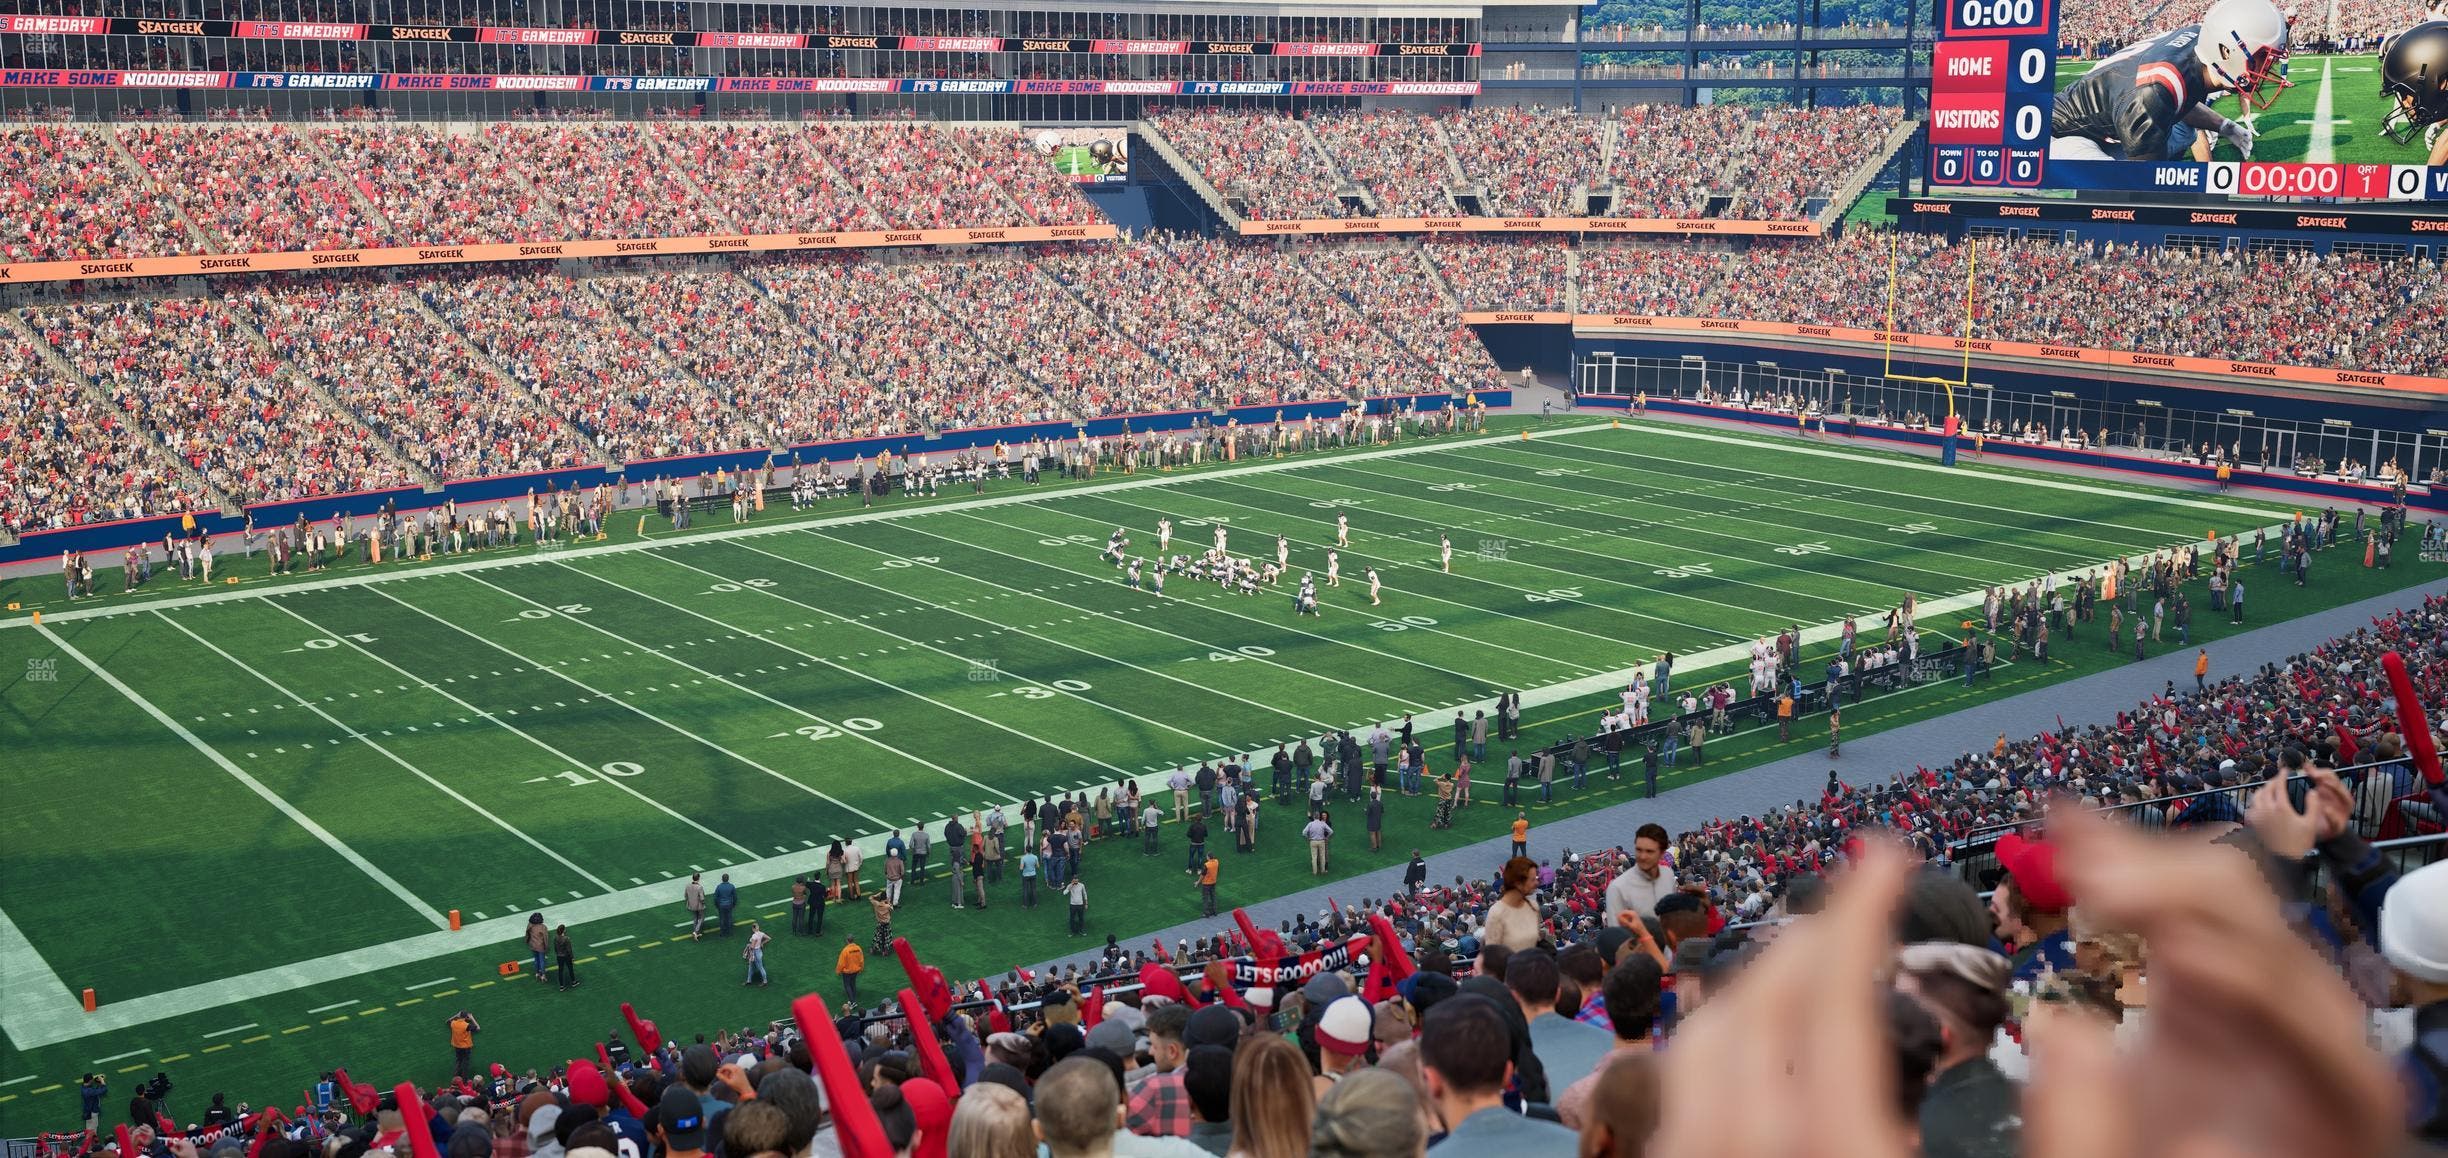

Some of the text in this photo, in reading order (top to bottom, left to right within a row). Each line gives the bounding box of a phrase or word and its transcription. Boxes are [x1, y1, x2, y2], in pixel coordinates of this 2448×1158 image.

[1962, 0, 2034, 26] 0:00
[14, 18, 94, 32] GAMEDAY!
[138, 21, 204, 35] SEATGEEK
[253, 24, 354, 38] IT'S GAMEDAY!
[392, 27, 452, 40] SEATGEEK
[495, 30, 585, 43] IT'S GAMEDAY!
[620, 32, 673, 44] SEATGEEK
[713, 35, 797, 47] IT'S GAMEDAY!
[828, 36, 878, 48] SEATGEEK
[915, 39, 935, 49] IT'S
[938, 39, 993, 50] GAMEDAY!
[1023, 40, 1070, 51] SEATGEEK
[1105, 41, 1179, 52] IT'S GAMEDAY!
[1208, 43, 1254, 54] SEATGEEK
[1288, 45, 1368, 55] IT'S GAMEDAY!
[1400, 45, 1448, 55] SEATGEEK
[1948, 57, 1993, 76] HOME
[2019, 48, 2046, 84] 0
[3, 72, 59, 84] MAKE
[67, 73, 118, 85] SOME
[252, 75, 373, 88] IT'S GAMEDAY!
[397, 77, 443, 88] MAKE
[450, 77, 490, 88] SOME
[605, 78, 709, 90] IT'S GAMEDAY!
[730, 80, 769, 90] MAKE
[776, 80, 812, 90] SOME
[913, 81, 1007, 92] IT'S GAMEDAY!
[1026, 82, 1062, 92] MAKE
[1068, 82, 1101, 92] SOME
[1195, 84, 1284, 94] IT'S GAMEDAY!
[1304, 84, 1343, 93] MAKE
[1350, 84, 1389, 94] SOME
[1935, 110, 1999, 128] VISITORS
[2016, 105, 2042, 140] 0
[2012, 150, 2028, 158] BALL
[1944, 159, 1957, 176] 0
[1980, 160, 1993, 177] 0
[2018, 160, 2031, 178] 0
[2357, 164, 2378, 175] QRT
[2155, 167, 2199, 186] HOME
[2213, 165, 2233, 189] 0
[2245, 165, 2338, 194] 00:00
[2398, 169, 2419, 194] 0
[2361, 176, 2370, 193] 1
[1913, 203, 1951, 214] SEATGEEK
[2000, 205, 2040, 217] SEATGEEK
[2092, 209, 2135, 220] SEATGEEK
[1425, 220, 1462, 228] SEATGEEK
[1504, 220, 1541, 228] SEATGEEK
[1589, 220, 1627, 228] SEATGEEK
[2191, 212, 2237, 224] SEATGEEK
[2297, 216, 2348, 229] SEATGEEK
[1266, 222, 1301, 231] SEATGEEK
[1345, 221, 1380, 229] SEATGEEK
[1676, 222, 1715, 230] SEATGEEK
[1767, 223, 1809, 232] SEATGEEK
[885, 232, 922, 242] SEATGEEK
[968, 230, 1005, 240] SEATGEEK
[1050, 228, 1086, 237] SEATGEEK
[709, 238, 749, 248] SEATGEEK
[798, 235, 837, 245] SEATGEEK
[519, 245, 563, 256] SEATGEEK
[616, 241, 658, 252] SEATGEEK
[312, 252, 360, 264] SEATGEEK
[418, 249, 464, 260] SEATGEEK
[80, 263, 134, 274] SEATGEEK
[200, 257, 250, 269] SEATGEEK
[1495, 313, 1535, 322] SEATGEEK
[1614, 317, 1652, 326] SEATGEEK
[1701, 320, 1739, 330] SEATGEEK
[1798, 326, 1831, 337] SEATGEEK
[1874, 332, 1909, 343] SEAGEEK
[2040, 347, 2080, 359] SEATGEEK
[2132, 355, 2175, 368] SEATGEEK
[2231, 363, 2276, 376] SEATGEEK
[2337, 372, 2385, 386] SEATGEEK
[1888, 523, 1938, 534] 10
[1774, 543, 1831, 555] 20
[1653, 565, 1714, 578] 30
[1524, 589, 1584, 603] 40
[1367, 615, 1438, 632] 50
[1209, 645, 1276, 664] 40
[1011, 679, 1093, 699] 30
[795, 717, 885, 741] 20
[553, 761, 645, 786] 10
[1235, 946, 1348, 983] LET'S GOOOOO!!!
